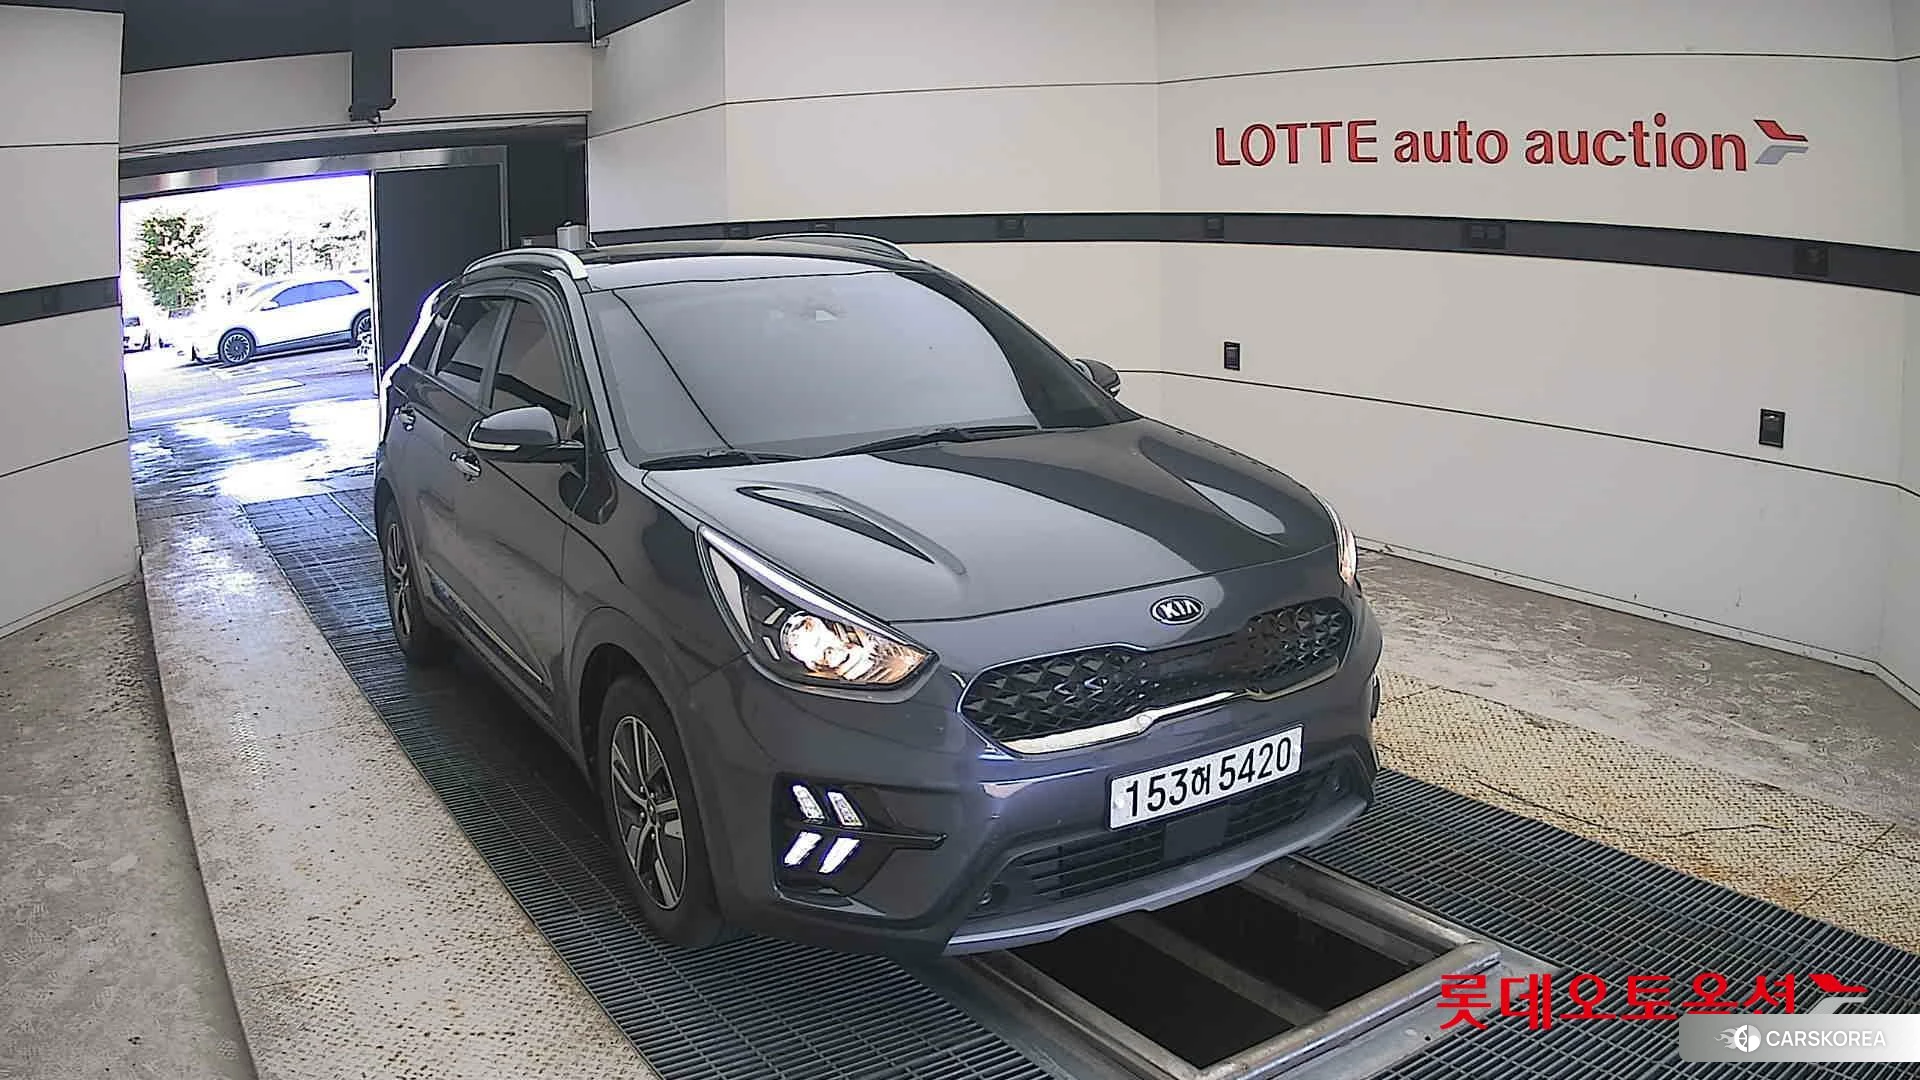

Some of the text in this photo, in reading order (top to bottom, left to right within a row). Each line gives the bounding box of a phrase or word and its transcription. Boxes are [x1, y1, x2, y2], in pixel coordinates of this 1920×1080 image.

[1215, 112, 1747, 172] LOTTE auto auction
[1159, 599, 1200, 619] KIA
[1218, 736, 1292, 791] 5420
